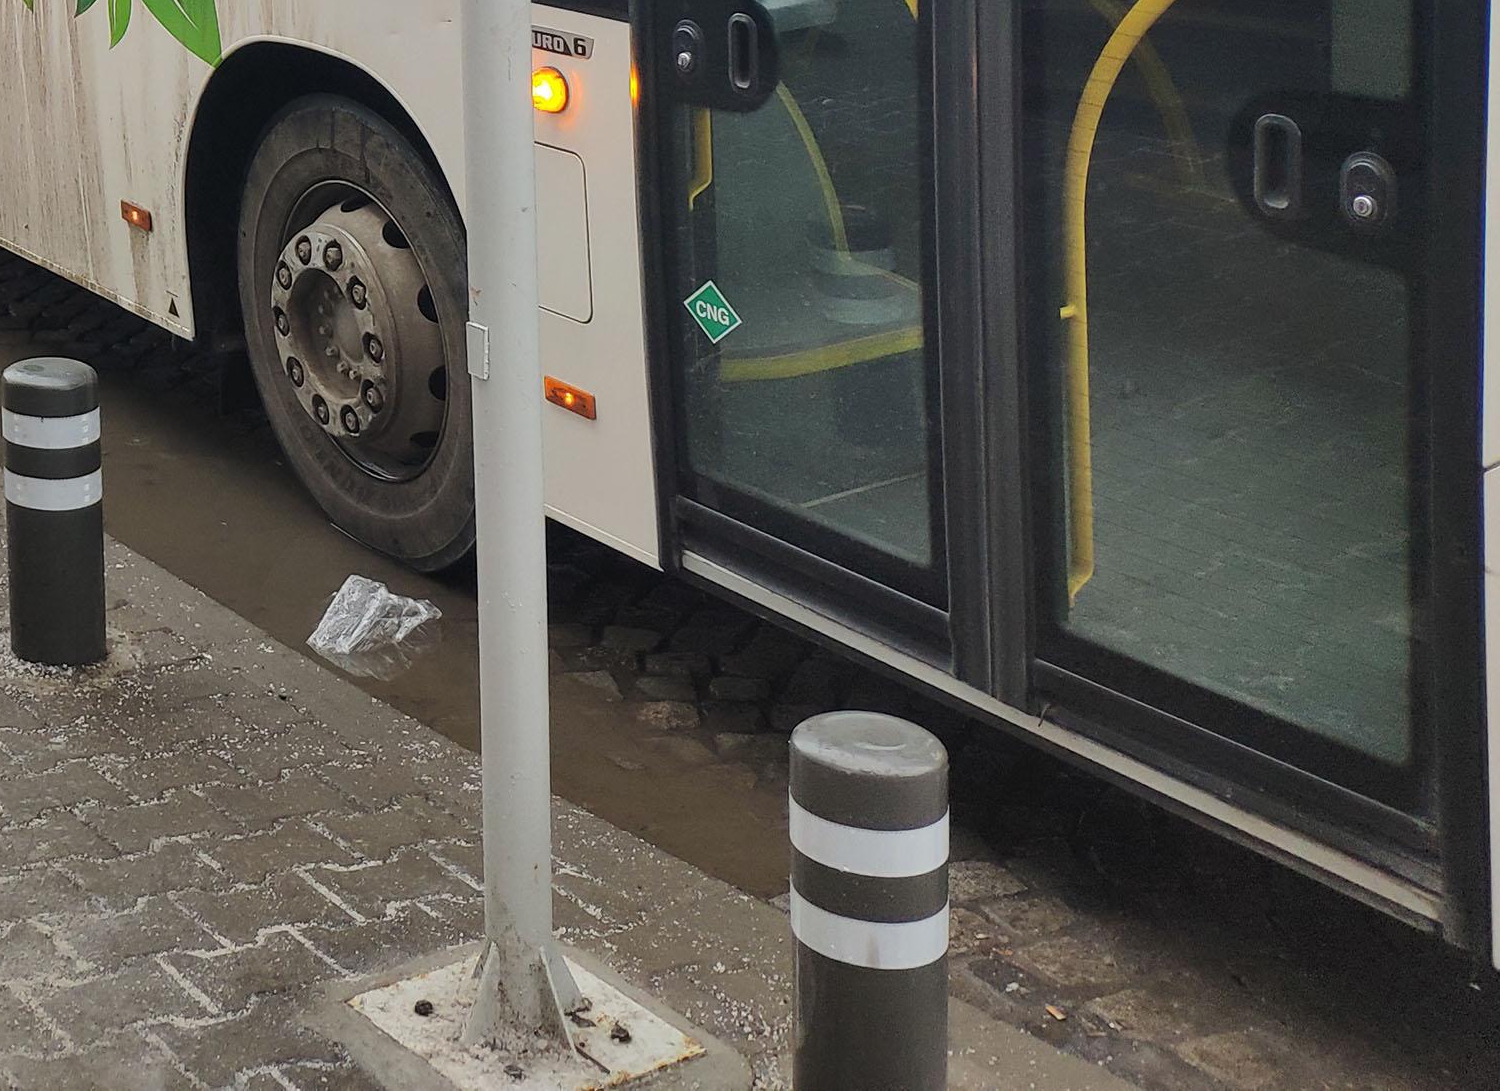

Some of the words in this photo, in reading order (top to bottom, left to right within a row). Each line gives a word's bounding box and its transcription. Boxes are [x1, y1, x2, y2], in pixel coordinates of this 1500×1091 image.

[532, 32, 564, 53] URO
[573, 37, 586, 56] 6
[696, 300, 730, 326] CNG
